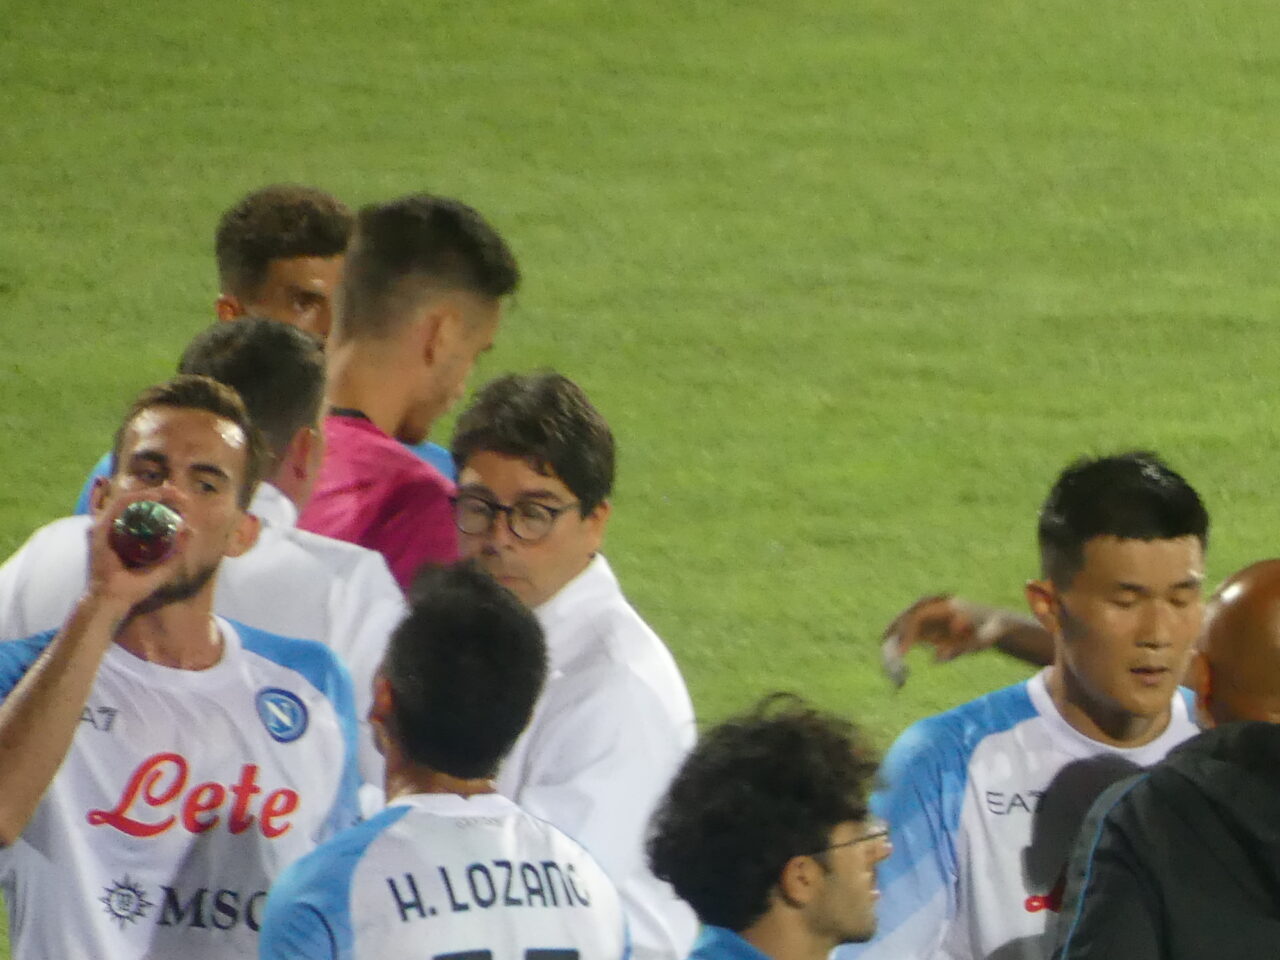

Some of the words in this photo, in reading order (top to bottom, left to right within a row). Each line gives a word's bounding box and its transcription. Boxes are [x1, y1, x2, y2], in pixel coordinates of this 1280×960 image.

[82, 705, 117, 732] A7
[86, 752, 300, 838] Lete
[386, 872, 437, 922] H.
